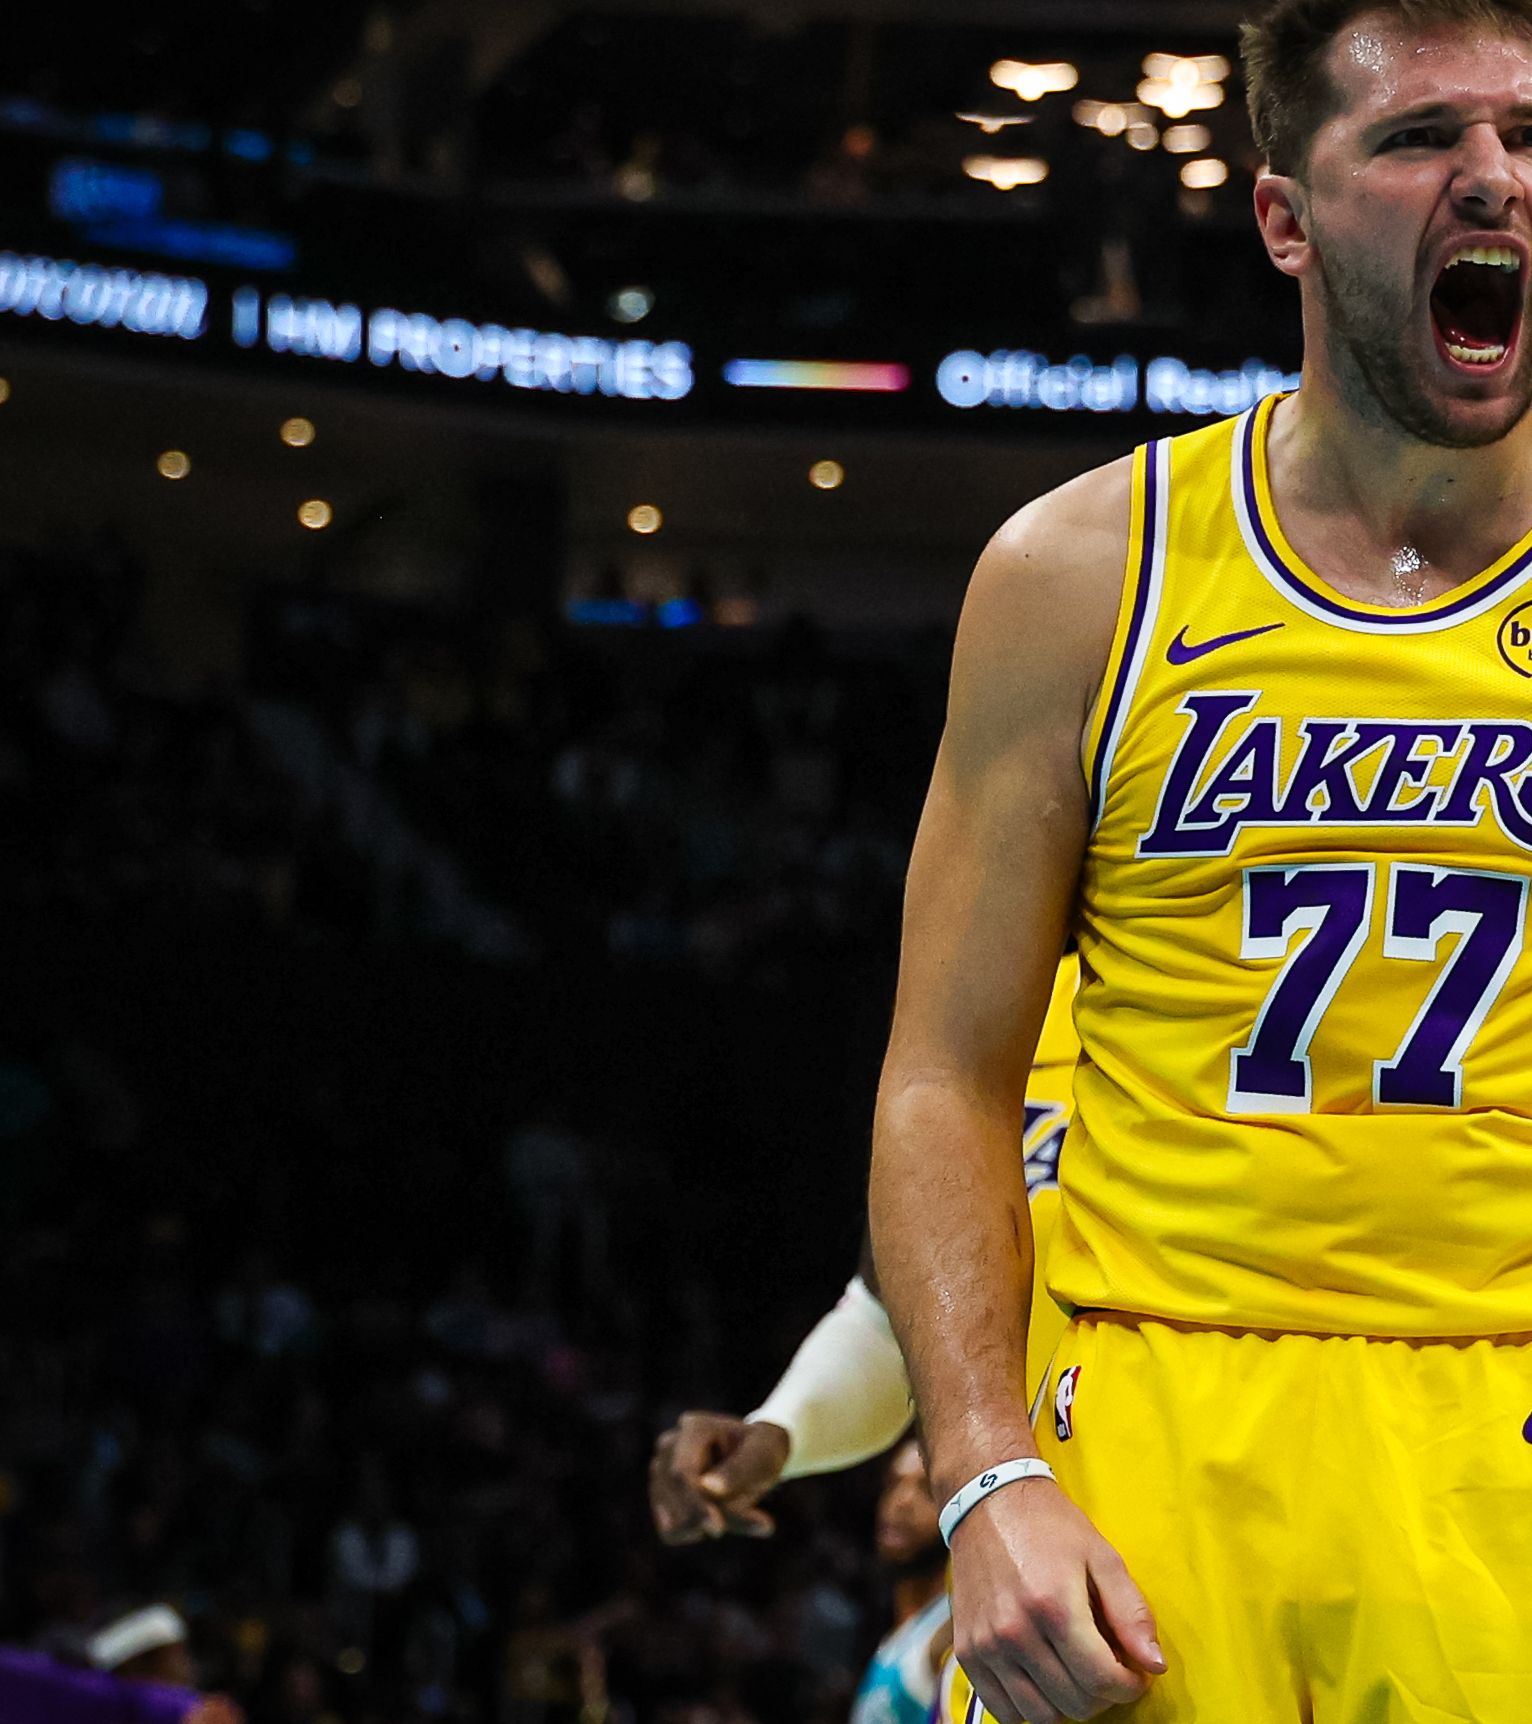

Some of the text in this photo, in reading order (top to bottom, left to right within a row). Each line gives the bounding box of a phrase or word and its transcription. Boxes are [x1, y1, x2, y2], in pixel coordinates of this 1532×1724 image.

[368, 308, 693, 400] PROPERTIES
[936, 349, 1137, 411] Official
[1226, 862, 1531, 1114] 77
